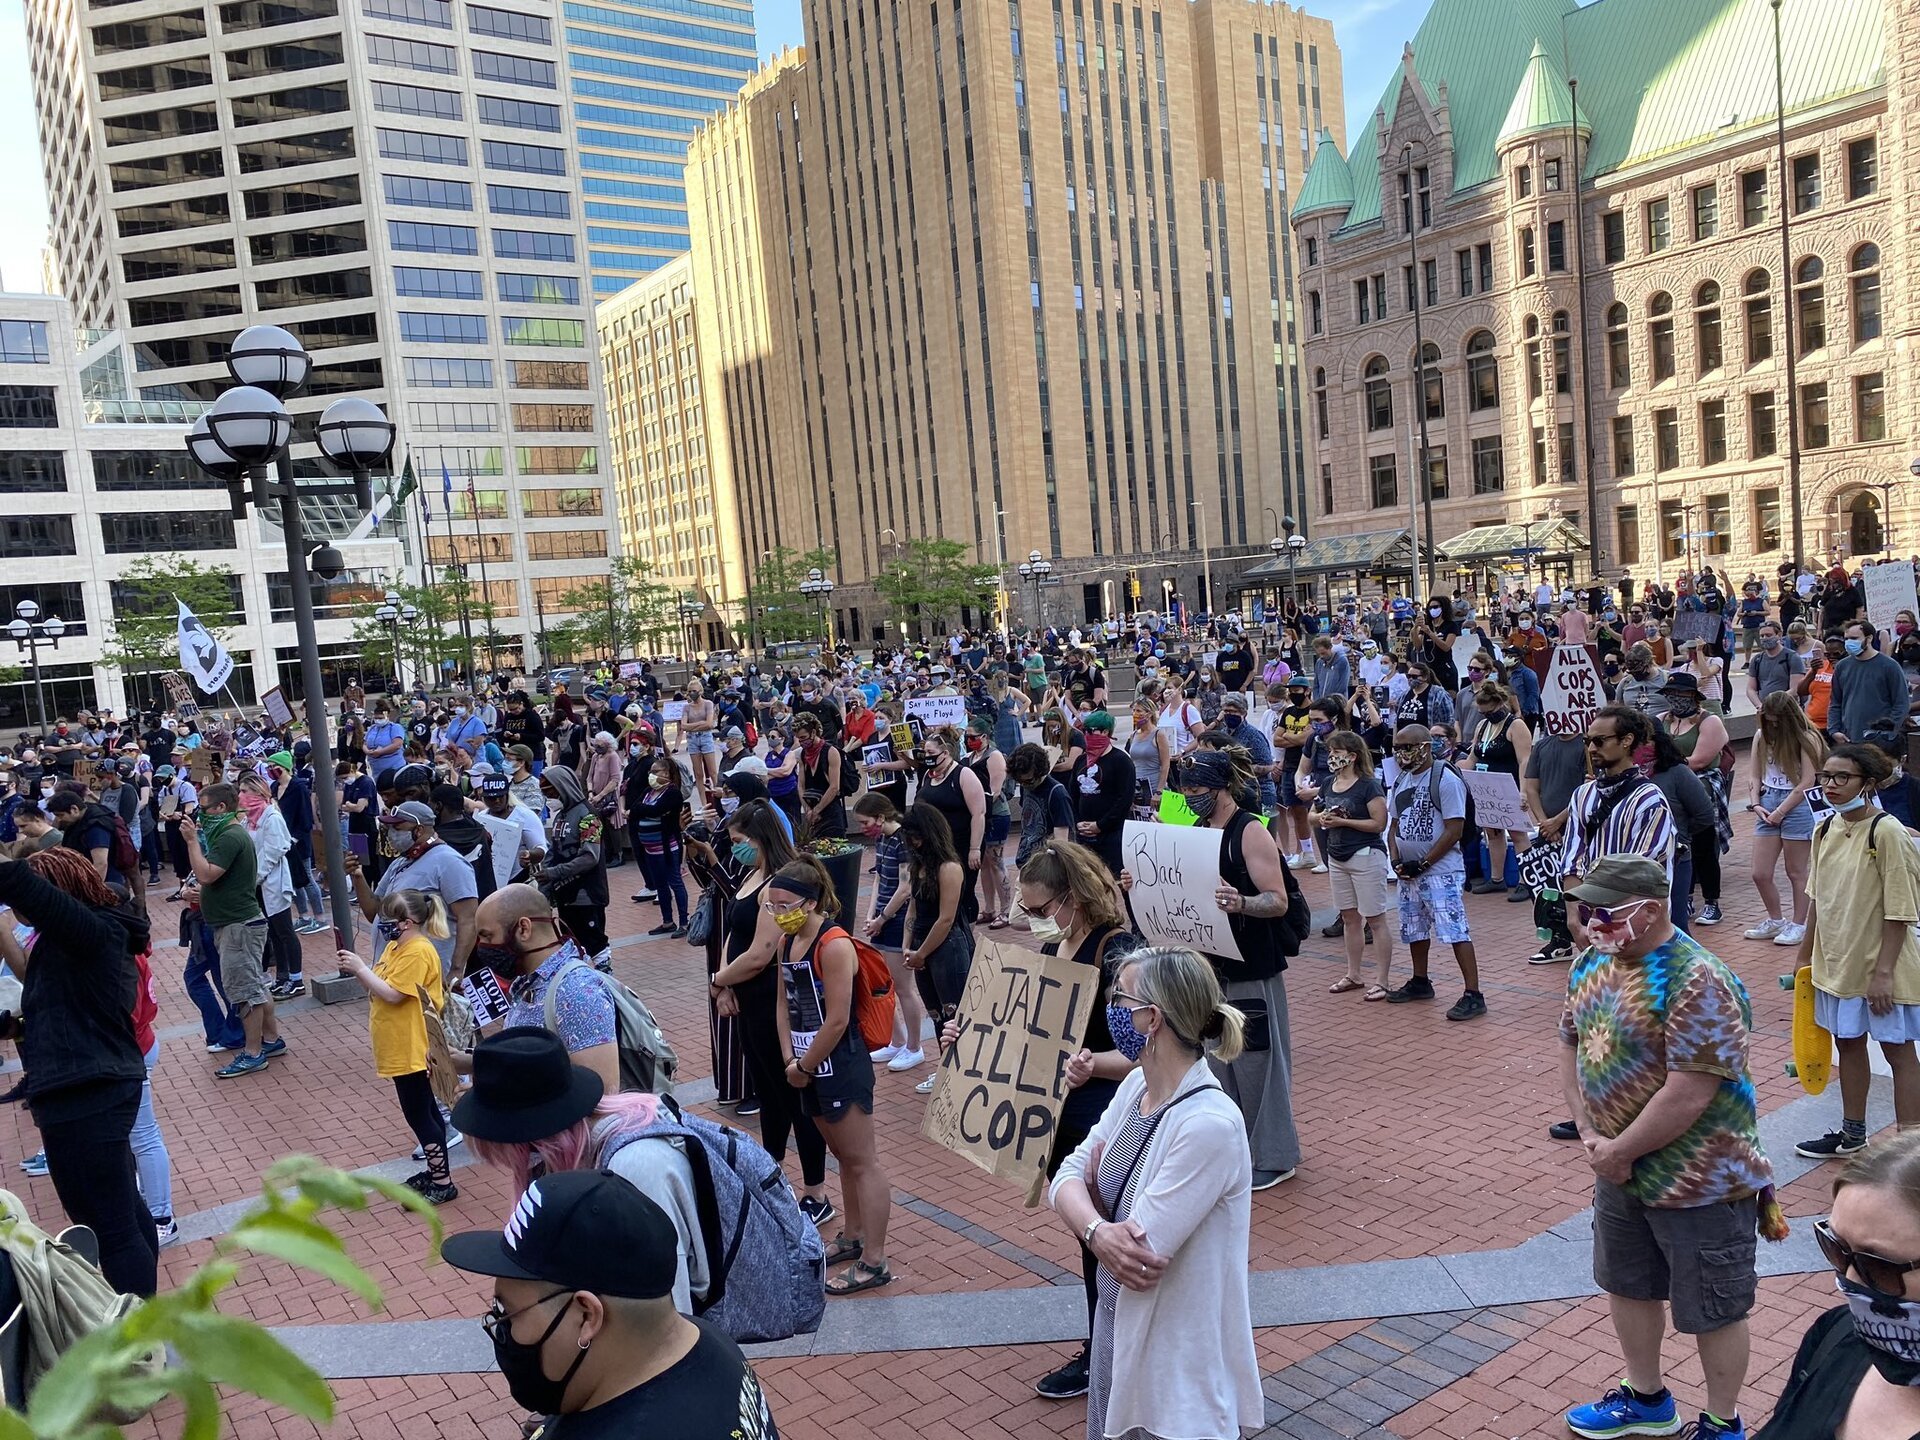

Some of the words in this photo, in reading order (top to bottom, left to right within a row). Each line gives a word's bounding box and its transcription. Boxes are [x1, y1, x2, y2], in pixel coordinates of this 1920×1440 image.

[1558, 648, 1587, 666] ALL
[1557, 667, 1595, 691] COPS
[908, 700, 921, 709] SAY
[925, 700, 935, 708] HIS
[938, 698, 958, 706] NAME
[1567, 691, 1597, 709] ARE
[934, 709, 954, 719] Floyd
[1545, 707, 1601, 735] BASTAR
[489, 780, 506, 789] PLUG
[1408, 817, 1434, 828] EVER
[1478, 812, 1515, 828] FLOYD
[1405, 827, 1434, 835] STAND
[1127, 829, 1184, 890] Black
[1160, 888, 1201, 921] Lives
[967, 943, 1004, 1012] BLM
[464, 981, 490, 1021] JUSTICE
[480, 969, 509, 1013] FLOYD
[991, 966, 1077, 1045] JAIL
